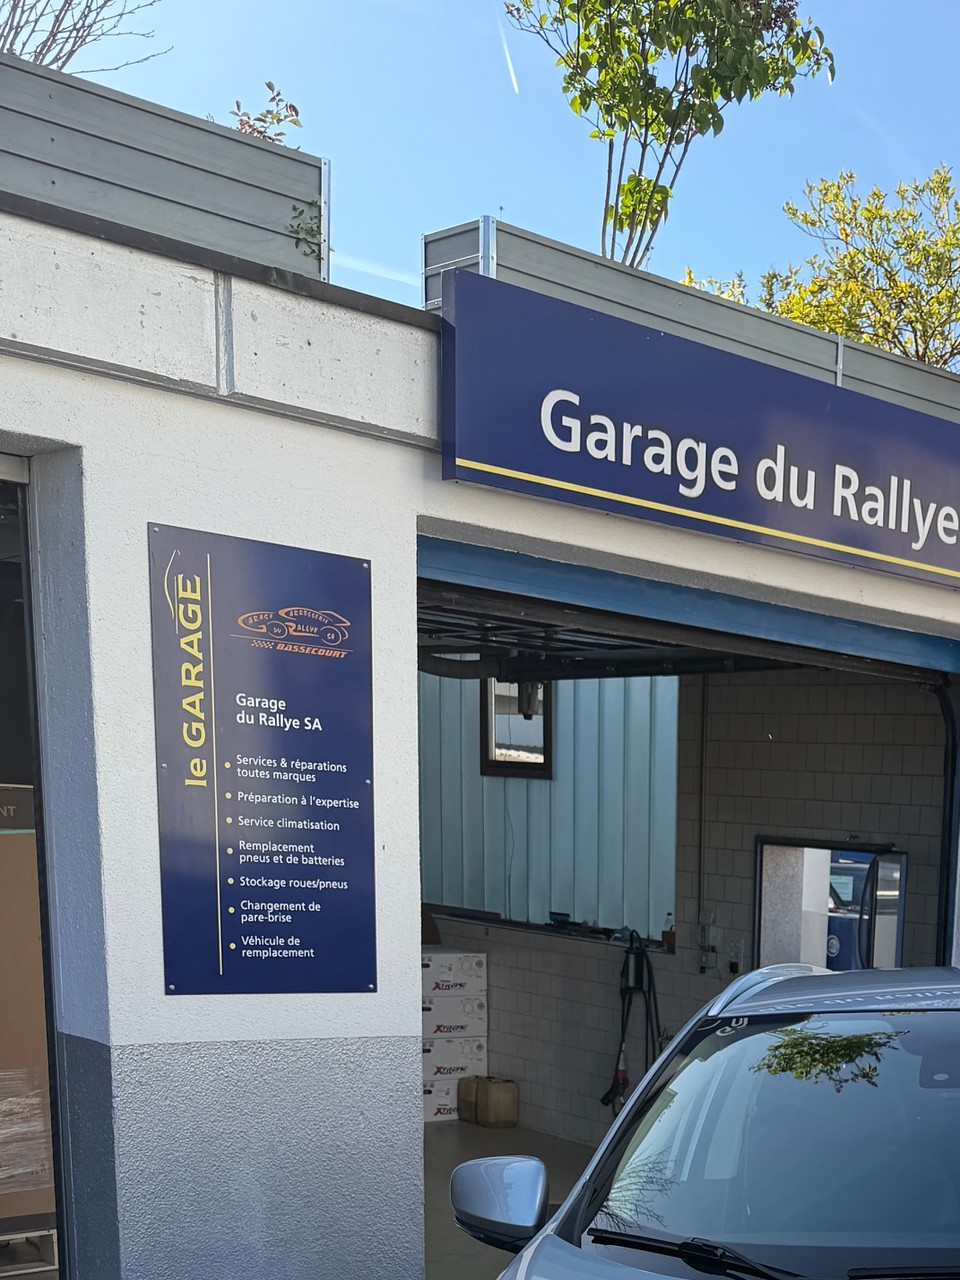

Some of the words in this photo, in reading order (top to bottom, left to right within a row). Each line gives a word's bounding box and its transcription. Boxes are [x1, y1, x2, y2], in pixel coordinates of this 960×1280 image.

[541, 389, 738, 497] Garage
[756, 444, 815, 510] du
[833, 464, 959, 550] Rallye
[275, 643, 348, 659] BASSECOURT
[177, 573, 206, 748] GARAGE
[235, 693, 287, 712] Garage
[236, 710, 254, 725] du
[259, 712, 301, 731] Rallye
[304, 717, 323, 731] SA
[236, 754, 278, 767] Services
[280, 758, 288, 768] &
[290, 758, 348, 773] réparations
[184, 757, 207, 787] le
[236, 767, 271, 779] toutes
[273, 773, 317, 783] marques
[237, 791, 299, 805] Préparation
[301, 795, 307, 806] à
[310, 795, 360, 809] l'expertise
[238, 816, 275, 828] Service
[277, 818, 340, 831] climatisation
[239, 840, 315, 853] Remplacement
[239, 854, 271, 865] pneus
[273, 855, 283, 864] et
[286, 854, 299, 864] de
[301, 855, 345, 866] batteries
[240, 876, 287, 889] Stockage
[289, 878, 348, 890] roues/pneus
[240, 900, 306, 913] Changement
[308, 901, 321, 911] de
[241, 911, 292, 924] pare-brise
[241, 935, 285, 946] Véhicule
[287, 936, 301, 946] de
[242, 947, 315, 959] remplacement
